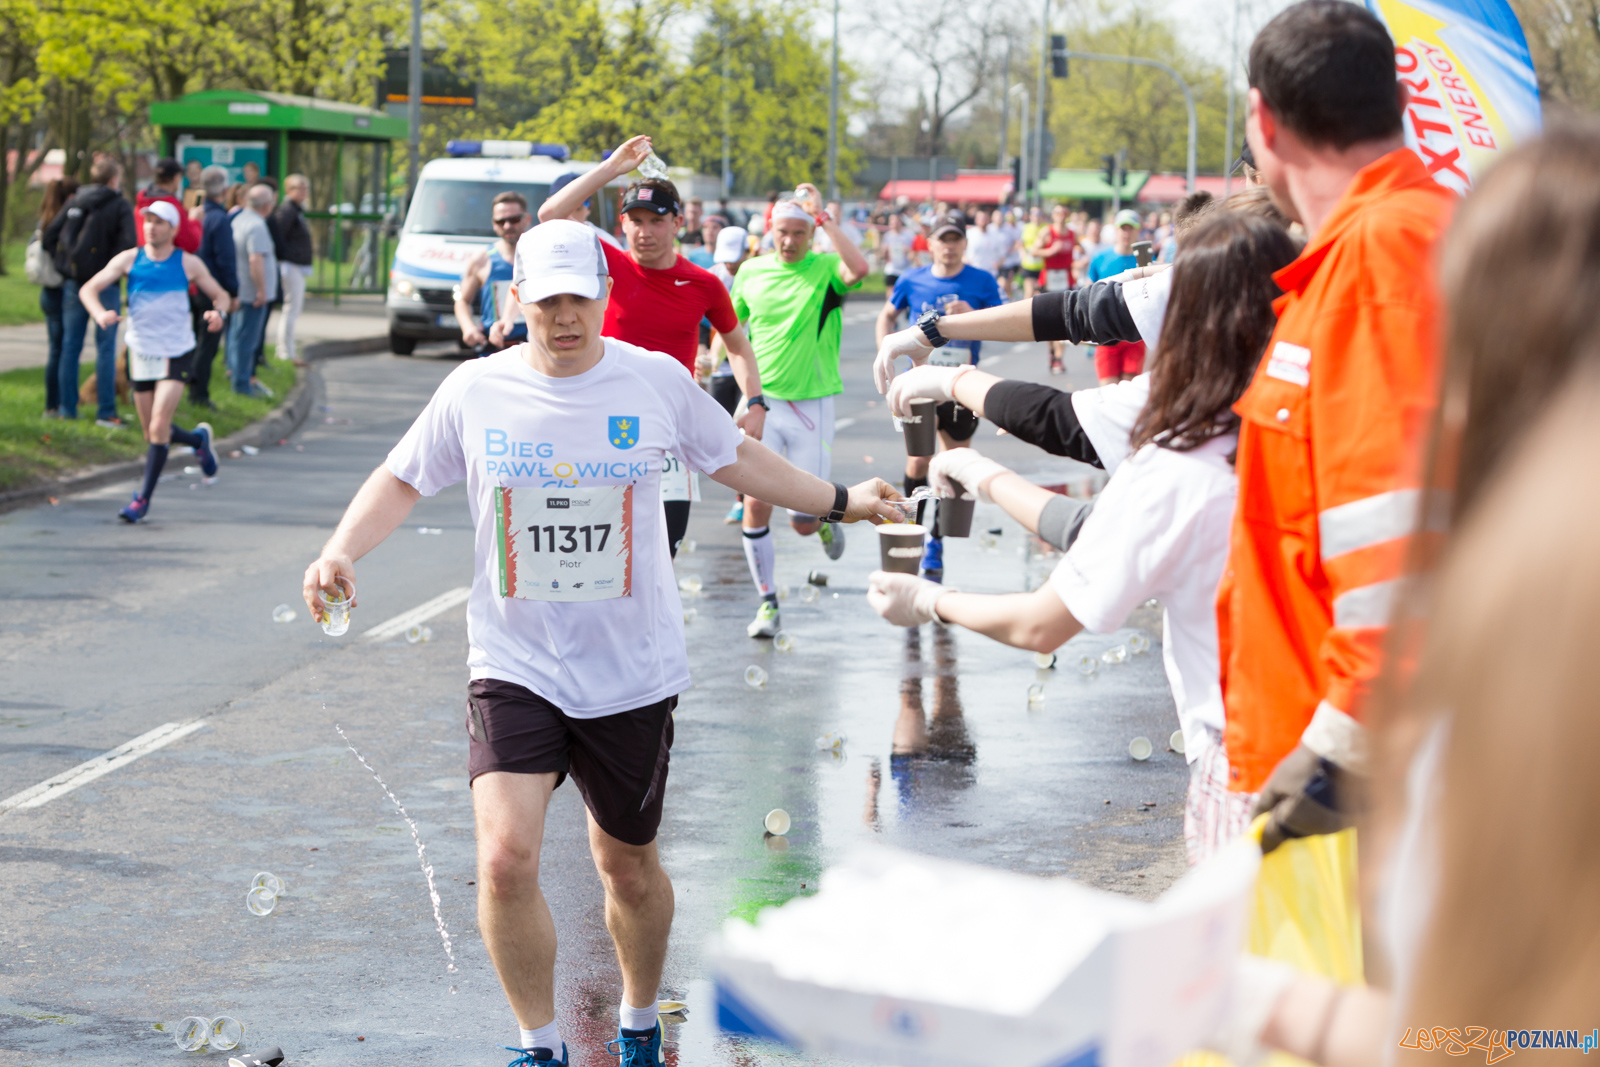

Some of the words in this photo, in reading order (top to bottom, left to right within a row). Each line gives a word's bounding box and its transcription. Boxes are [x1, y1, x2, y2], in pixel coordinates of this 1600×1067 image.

[1416, 42, 1498, 151] ENERGY
[527, 523, 612, 554] 11317
[559, 559, 582, 568] Piotr
